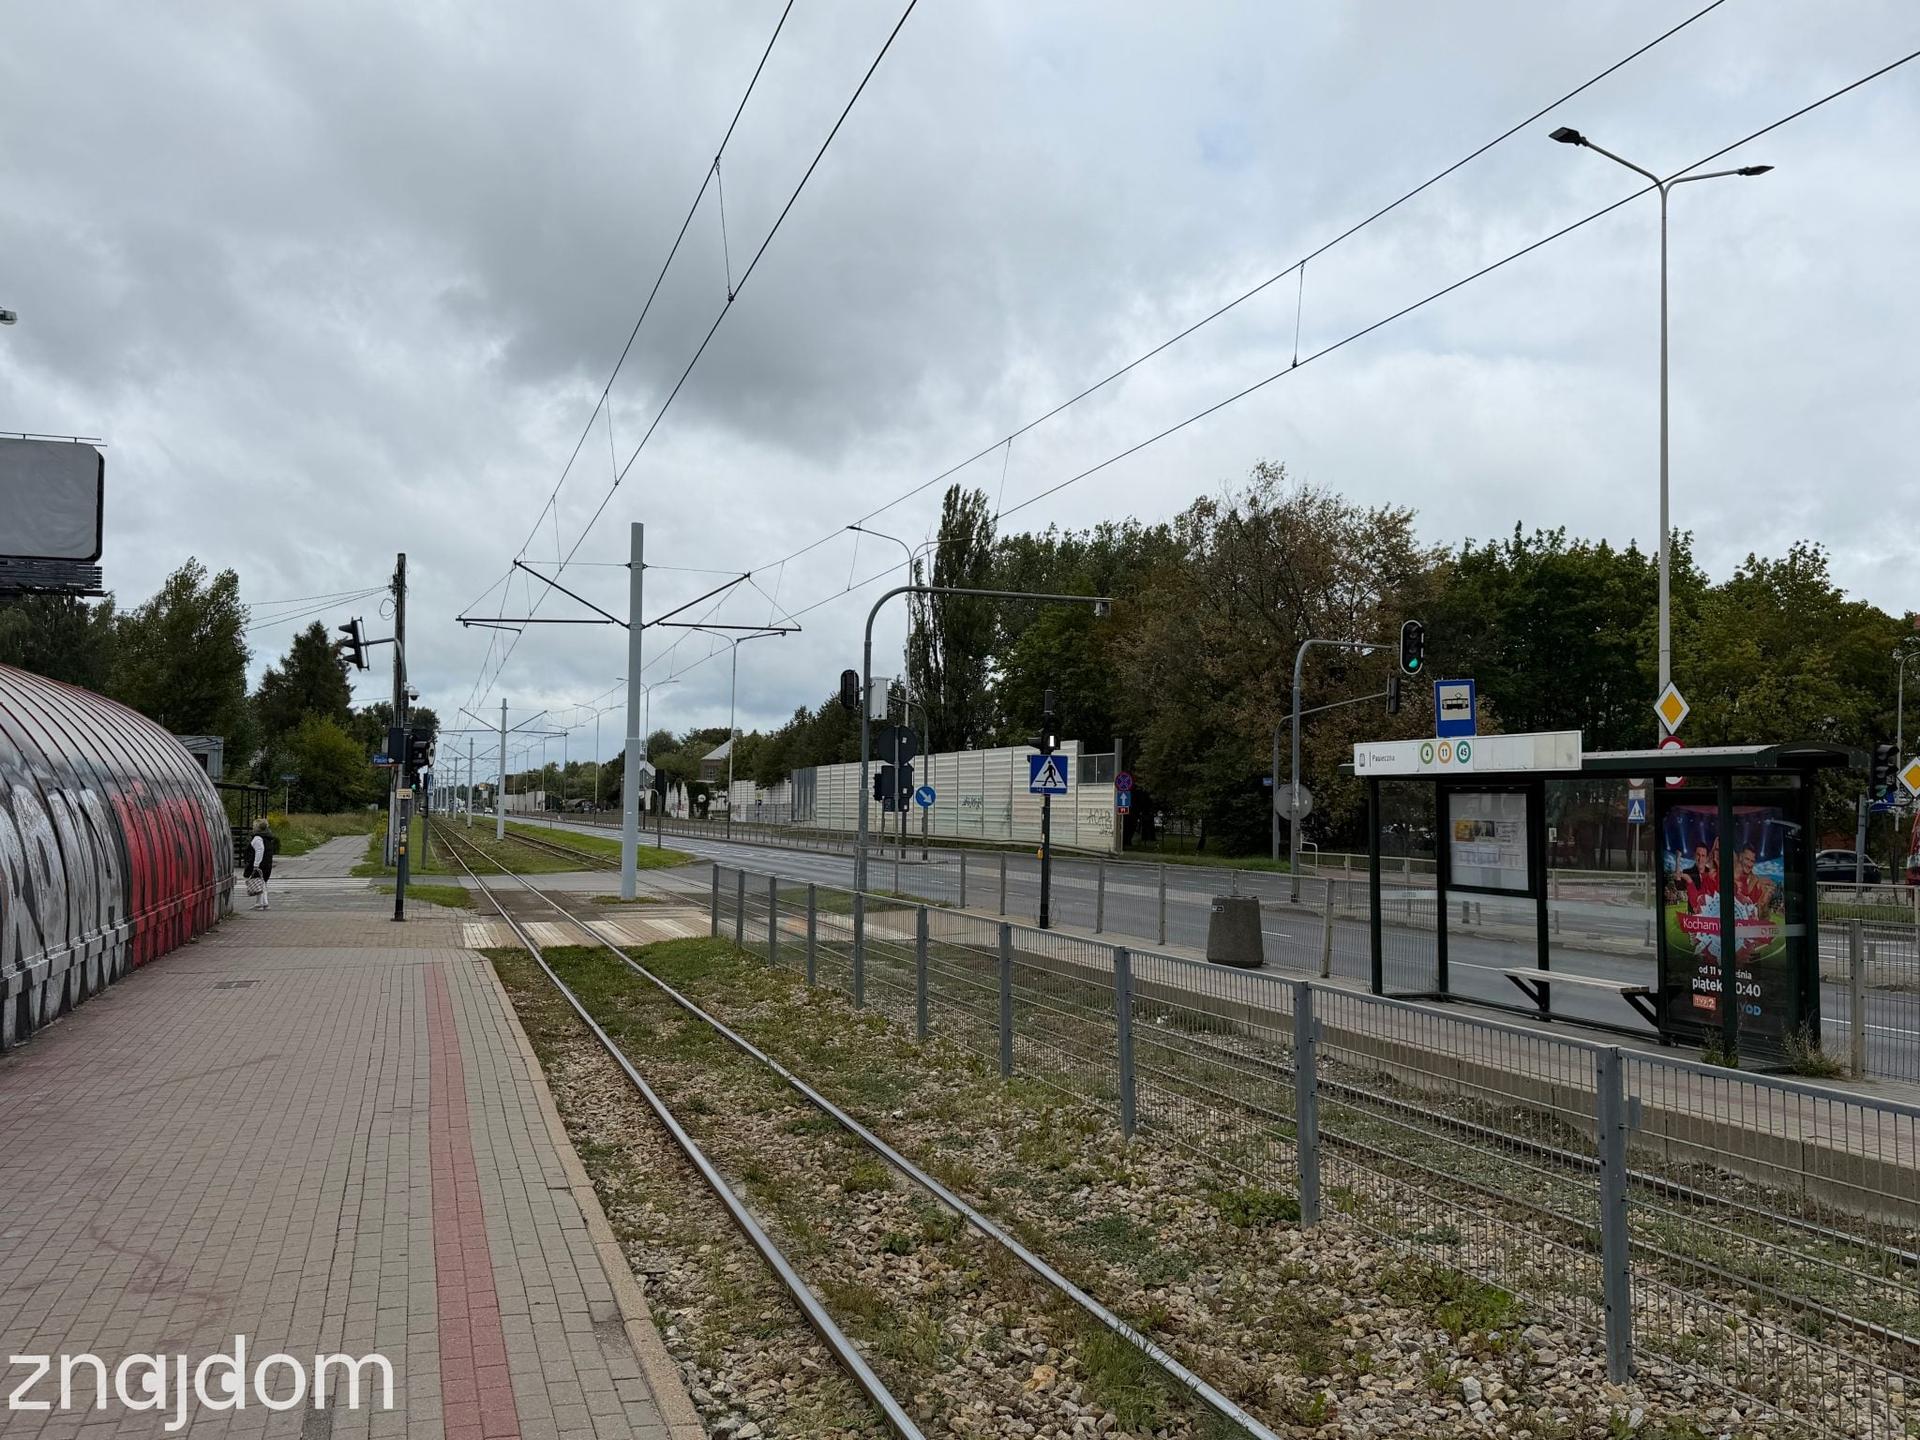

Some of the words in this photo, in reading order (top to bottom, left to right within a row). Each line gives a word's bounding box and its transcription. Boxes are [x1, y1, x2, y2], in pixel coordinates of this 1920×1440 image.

[1425, 748, 1430, 758] 4
[1441, 747, 1449, 758] 11
[1459, 747, 1468, 757] 45
[1683, 918, 1719, 931] Kocham
[1698, 965, 1708, 975] od
[1709, 966, 1716, 976] 11
[1692, 976, 1723, 992] piątek
[1735, 982, 1761, 997] 0:40
